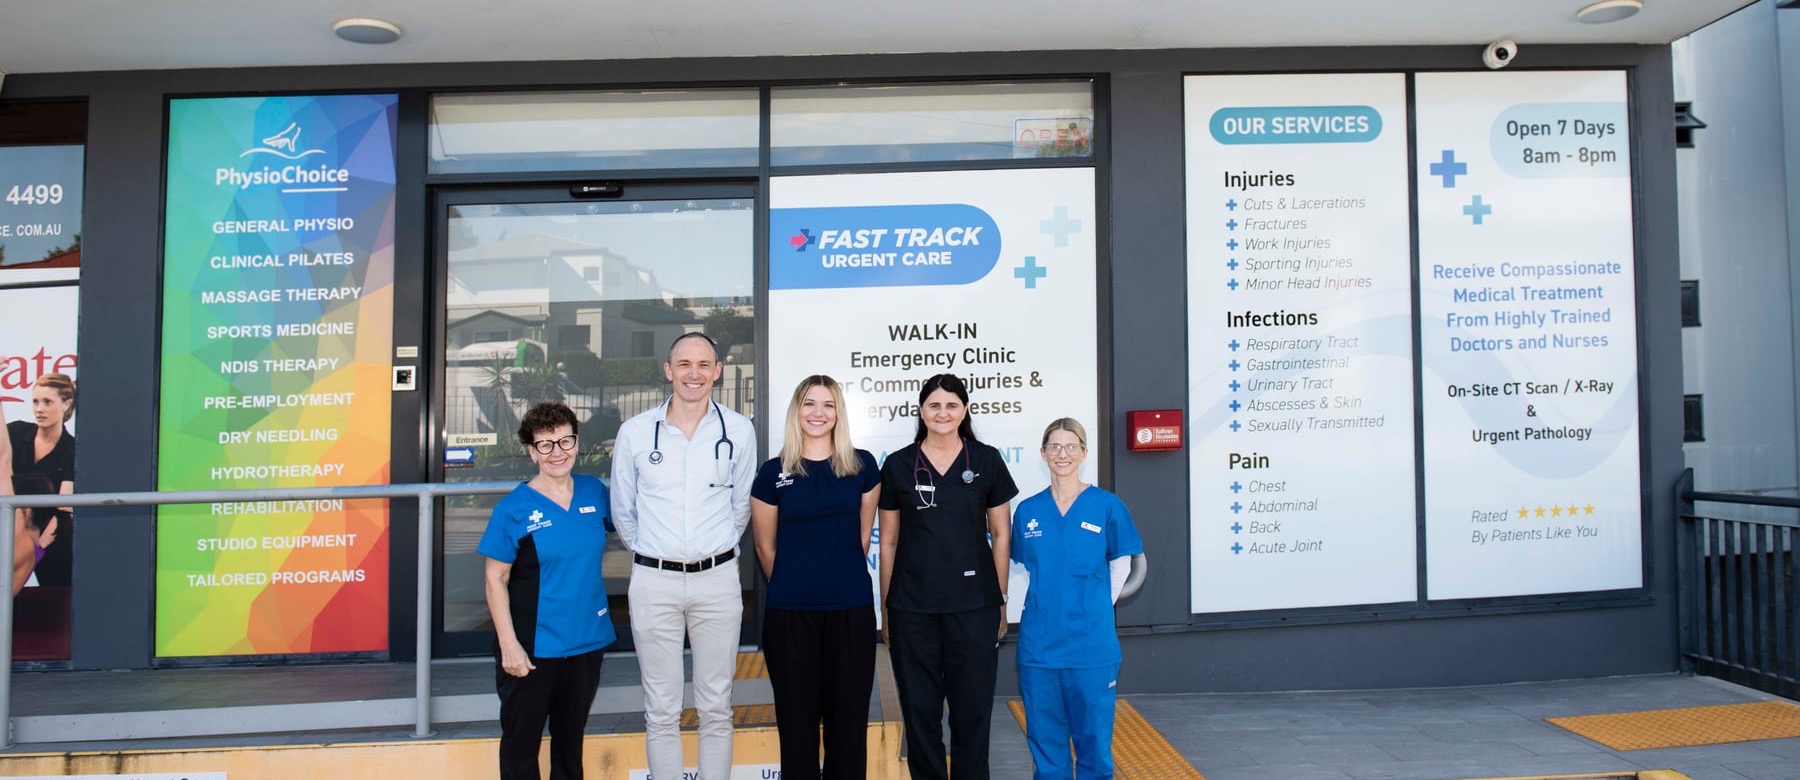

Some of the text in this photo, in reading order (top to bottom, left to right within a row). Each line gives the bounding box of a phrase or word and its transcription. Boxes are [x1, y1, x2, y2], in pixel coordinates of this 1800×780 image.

[1224, 115, 1369, 135] OUR SERVICES
[1506, 119, 1616, 140] Open 7 Days
[1020, 128, 1088, 149] OPEN
[1523, 148, 1560, 164] 8am
[1578, 146, 1616, 166] 8pm
[215, 164, 349, 190] PhysioChoice
[1224, 170, 1295, 191] Injuries
[6, 184, 64, 206] 4499
[1244, 196, 1366, 210] Cuts & Lacerations
[16, 223, 62, 236] COM.AU
[212, 217, 354, 234] GENERAL PHYSIO
[1244, 218, 1308, 230] Fractures
[818, 226, 984, 250] FAST TRACK
[1245, 236, 1332, 252] Work Injuries
[210, 252, 354, 269] CLINICAL PILATES
[822, 251, 952, 268] URGENT CARE
[1244, 256, 1353, 272] Sporting Injuries
[1433, 260, 1621, 280] Receive Compassionate
[1245, 276, 1372, 290] Minor Head Injuries
[201, 287, 362, 304] MASSAGE THERAPY
[1453, 285, 1604, 302] Medical Treatment
[1226, 310, 1318, 328] Infections
[1446, 308, 1611, 329] From Highly Trained
[207, 322, 354, 338] SPORTS MEDICINE
[888, 322, 978, 342] WALK-IN
[1246, 335, 1360, 352] Respiratory Tract
[1450, 334, 1608, 352] Doctors and Nurses
[220, 358, 338, 374] NDIS THERAPY
[850, 347, 1016, 370] Emergency Clinic
[1246, 356, 1350, 371] Gastrointestinal
[1029, 371, 1044, 388] &
[1247, 376, 1334, 393] Urinary Tract
[1447, 378, 1614, 398] On-Site CT Scan / X-Ray
[204, 392, 354, 410] PRE-EMPLOYMENT
[1246, 395, 1362, 412] Abscesses & Skin
[1526, 404, 1537, 418] &
[1248, 414, 1385, 433] Sexually Transmitted
[218, 428, 338, 444] DRY NEEDLING
[456, 436, 489, 444] Entrance
[1472, 426, 1592, 445] Urgent Pathology
[1229, 452, 1270, 470] Pain
[211, 463, 344, 480] HYDROTHERAPY
[1248, 480, 1286, 493] Chest
[211, 498, 344, 515] REHABILITATION
[1248, 498, 1318, 514] Abdominal
[1472, 509, 1508, 523] Rated
[1249, 520, 1282, 534] Back
[1472, 525, 1598, 546] By Patients Like You
[196, 534, 356, 551] STUDIO EQUIPMENT
[1249, 540, 1323, 555] Acute Joint
[186, 570, 366, 586] TAILORED PROGRAMS
